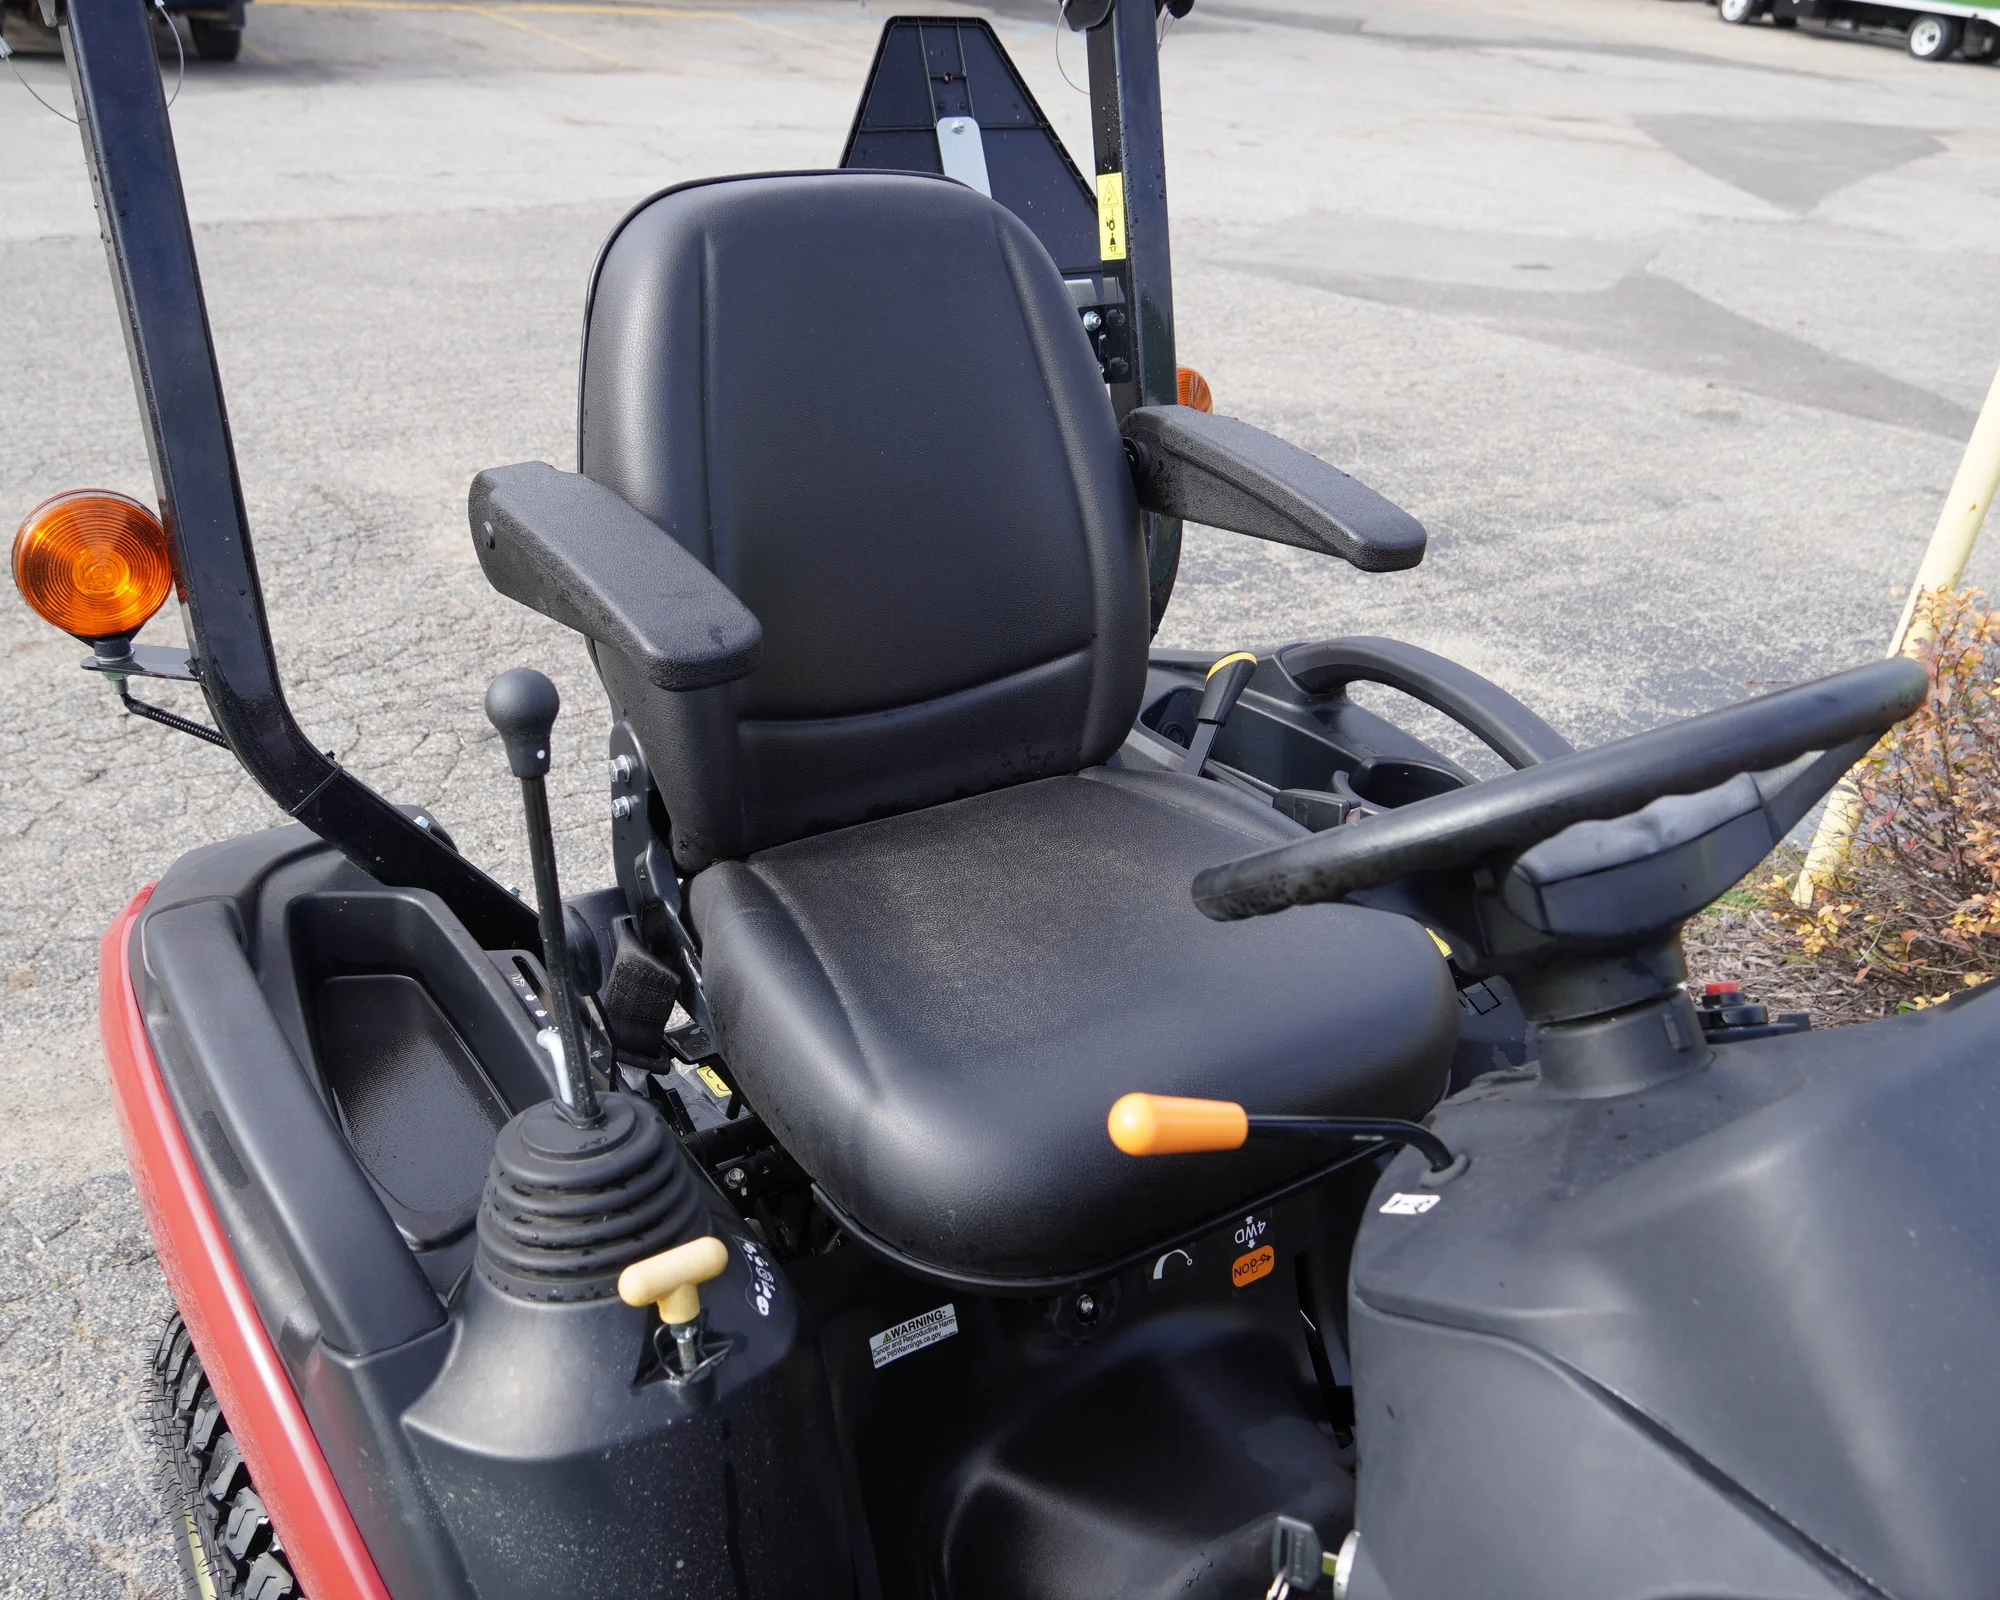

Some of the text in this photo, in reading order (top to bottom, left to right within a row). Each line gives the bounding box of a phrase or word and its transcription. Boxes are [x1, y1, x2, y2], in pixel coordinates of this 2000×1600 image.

[1234, 1221, 1266, 1244] 4WD
[891, 1310, 946, 1338] WARNING:
[872, 1344, 891, 1358] Cancer
[891, 1339, 902, 1349] and
[903, 1325, 939, 1343] Reproductive
[874, 1331, 941, 1365] www.P65Warnings.ca.gov
